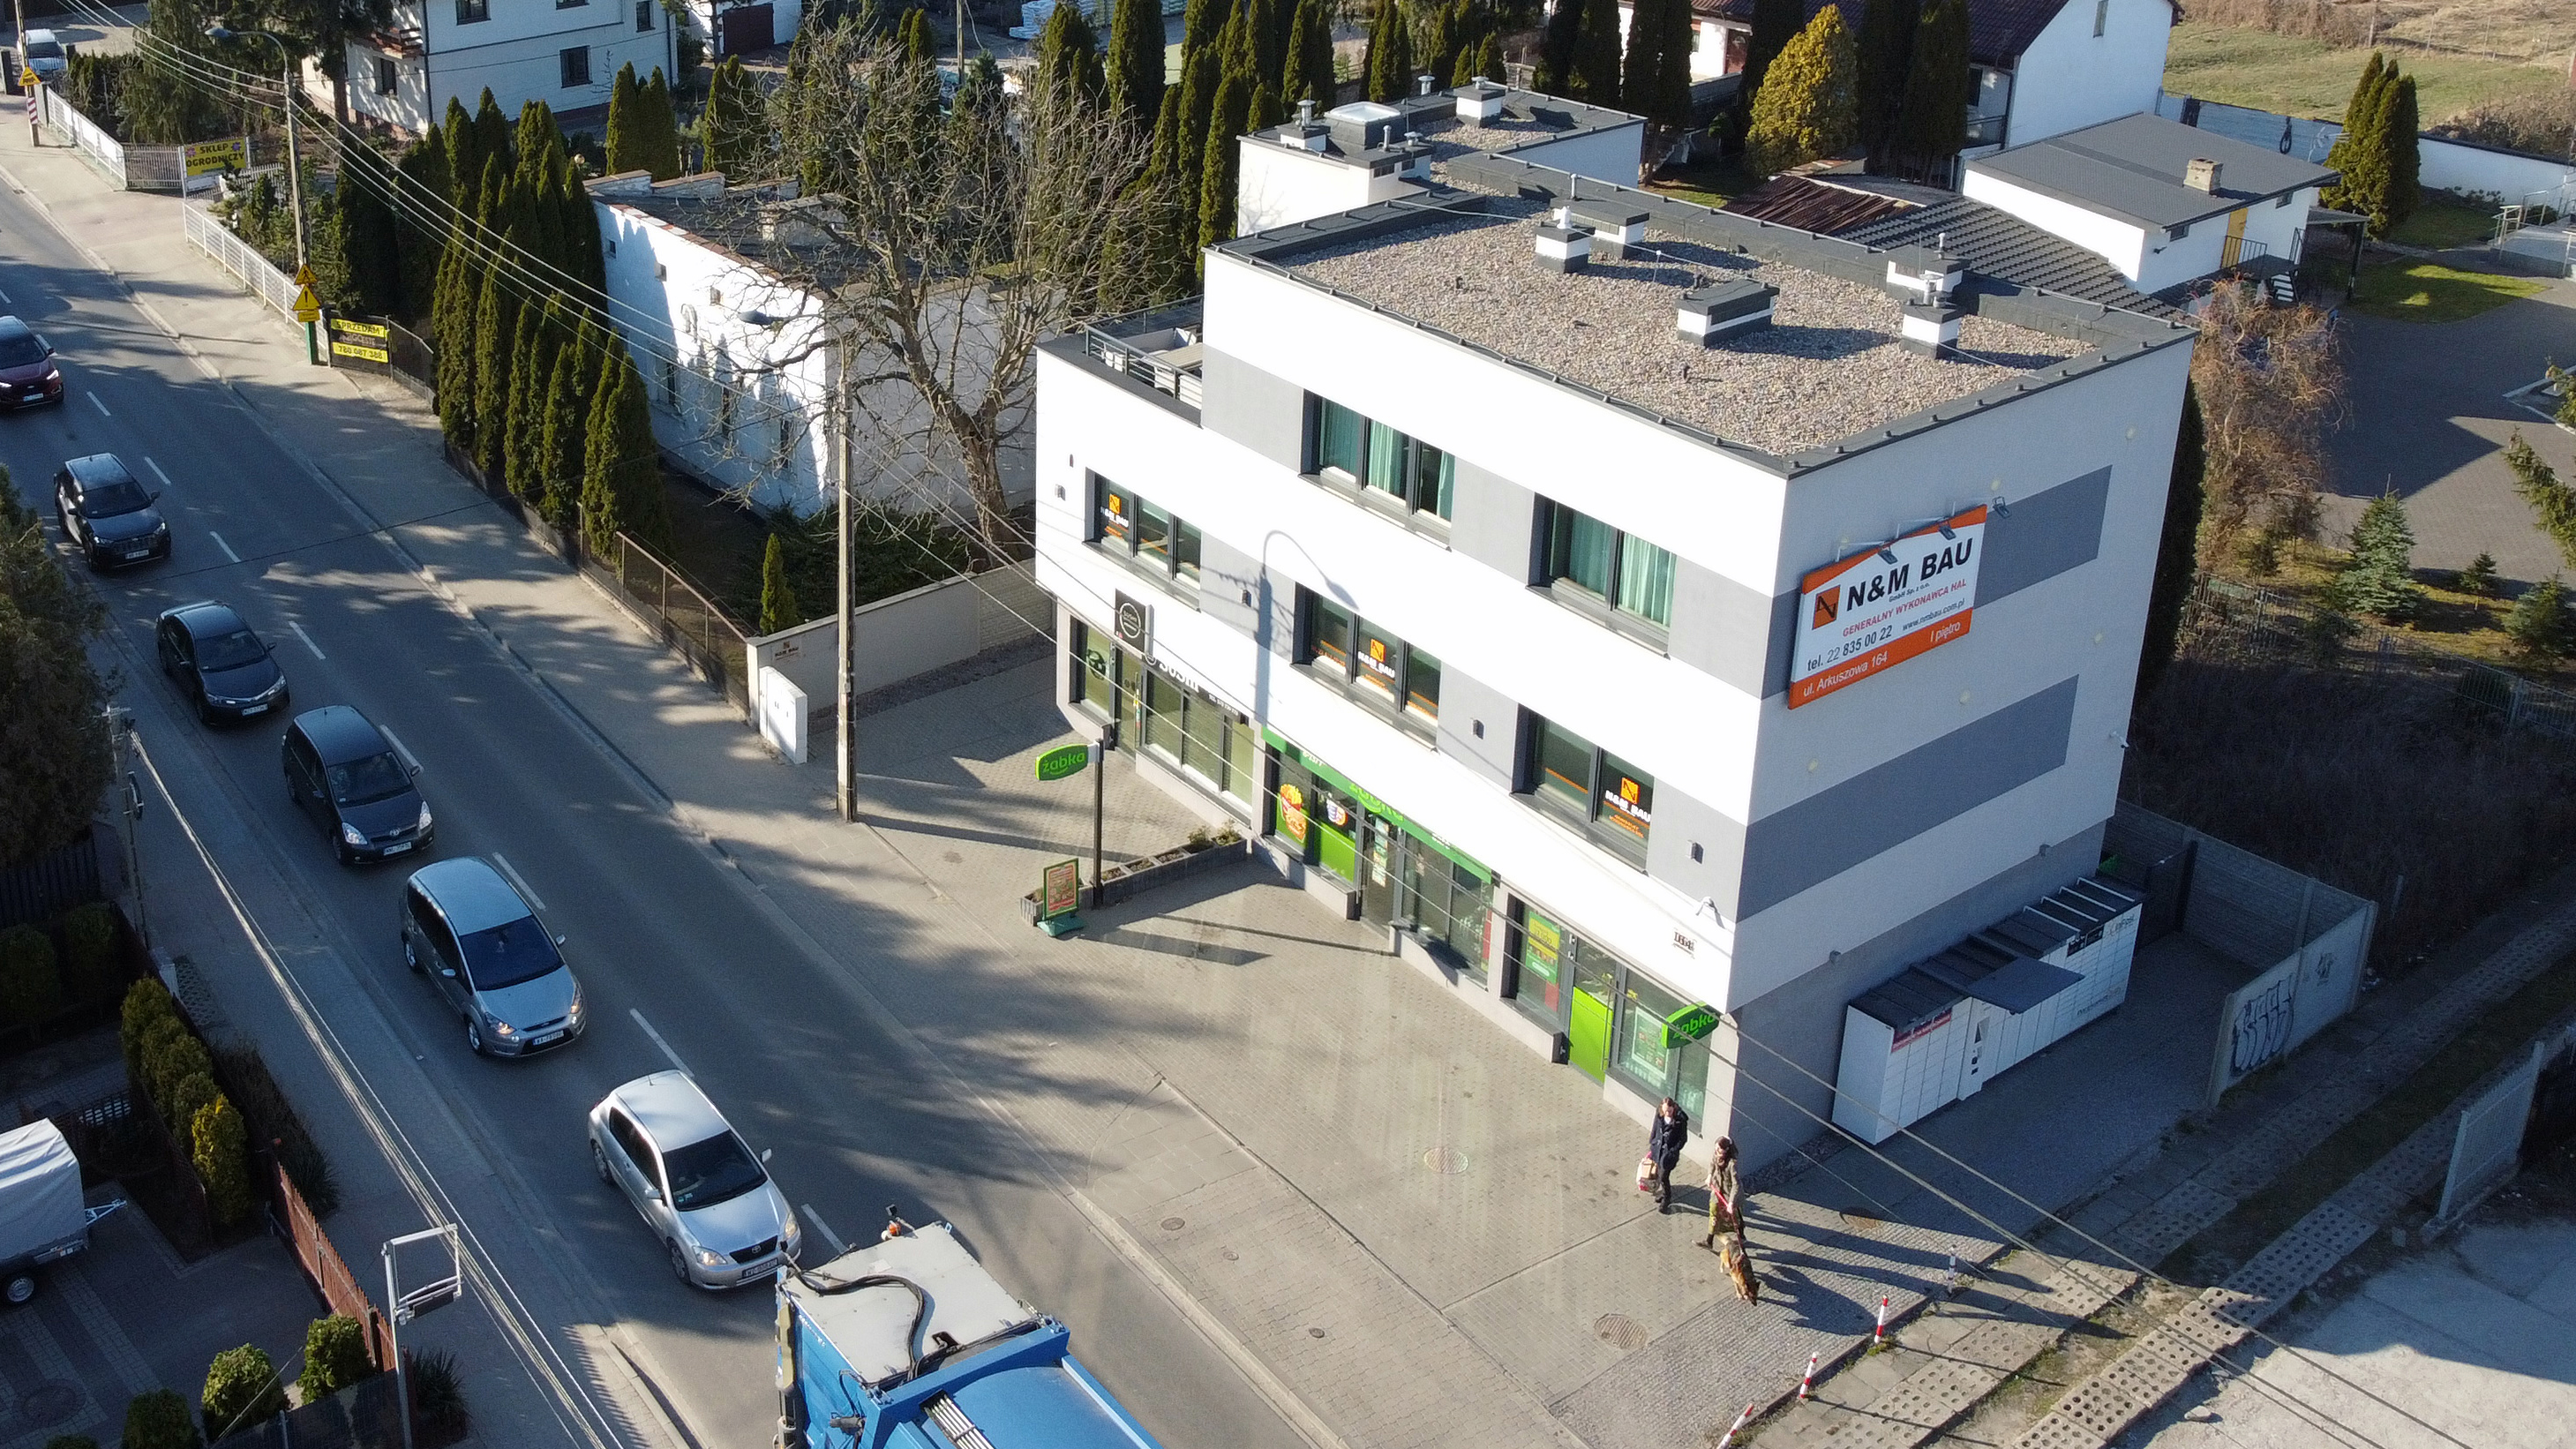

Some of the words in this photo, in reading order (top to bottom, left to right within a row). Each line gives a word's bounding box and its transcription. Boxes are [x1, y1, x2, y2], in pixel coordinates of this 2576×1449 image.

[186, 152, 244, 167] OGRODNICZY
[199, 143, 229, 154] SKLEP
[1847, 563, 1910, 612] N&M
[1920, 537, 1973, 582] BAU
[1843, 609, 1894, 636] GENERALNY
[1896, 586, 1949, 615] WYKONAWCA
[1951, 579, 1966, 592] HAL
[1807, 655, 1823, 671] tel.
[1827, 647, 1840, 663] 22
[1843, 637, 1862, 656] 835
[1864, 631, 1877, 647] 00
[1879, 625, 1892, 641] 22
[1935, 621, 1961, 642] piętro
[1803, 683, 1814, 697] ul.
[1816, 662, 1868, 691] Arkuszowa
[1872, 650, 1888, 668] 164
[1042, 752, 1085, 773] żabka
